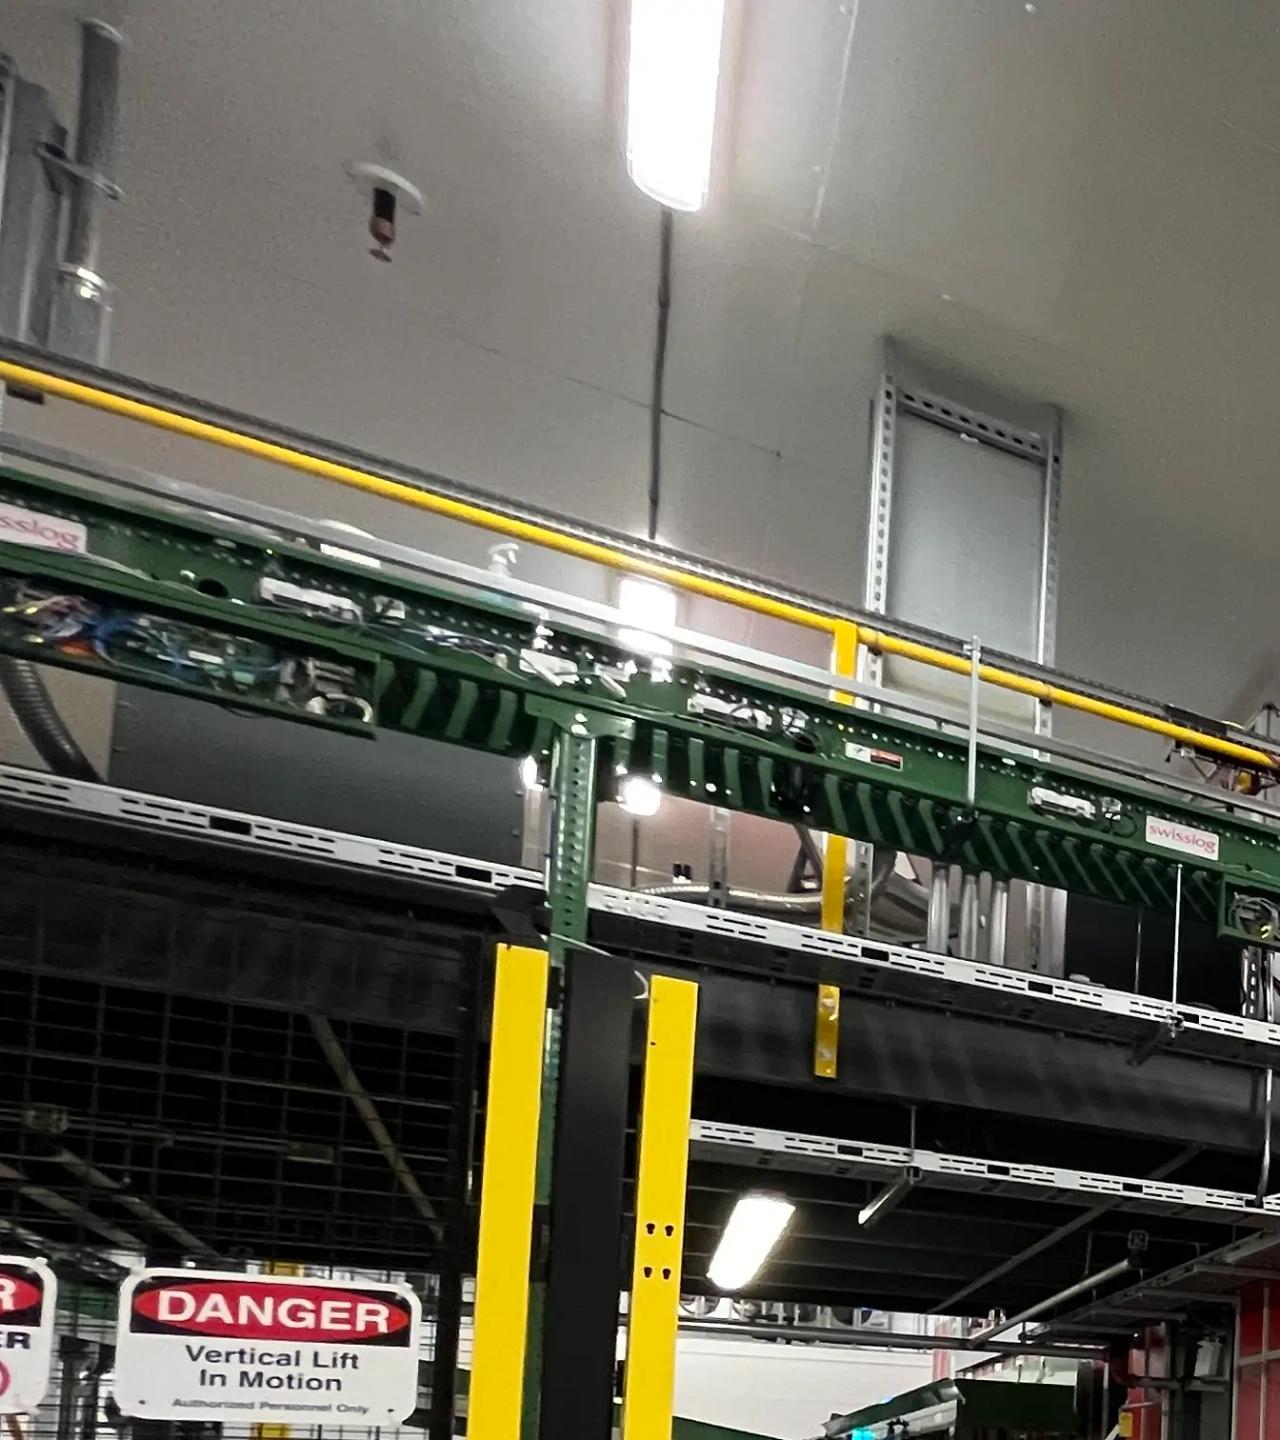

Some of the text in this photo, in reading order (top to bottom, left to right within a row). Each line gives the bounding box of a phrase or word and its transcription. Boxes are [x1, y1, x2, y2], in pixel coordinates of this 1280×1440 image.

[1149, 824, 1216, 854] swisslog
[156, 1290, 390, 1333] DANGER
[185, 1344, 360, 1370] Vertical Lift
[200, 1369, 343, 1392] In Motion
[171, 1398, 370, 1416] Authorized Personnel Only
